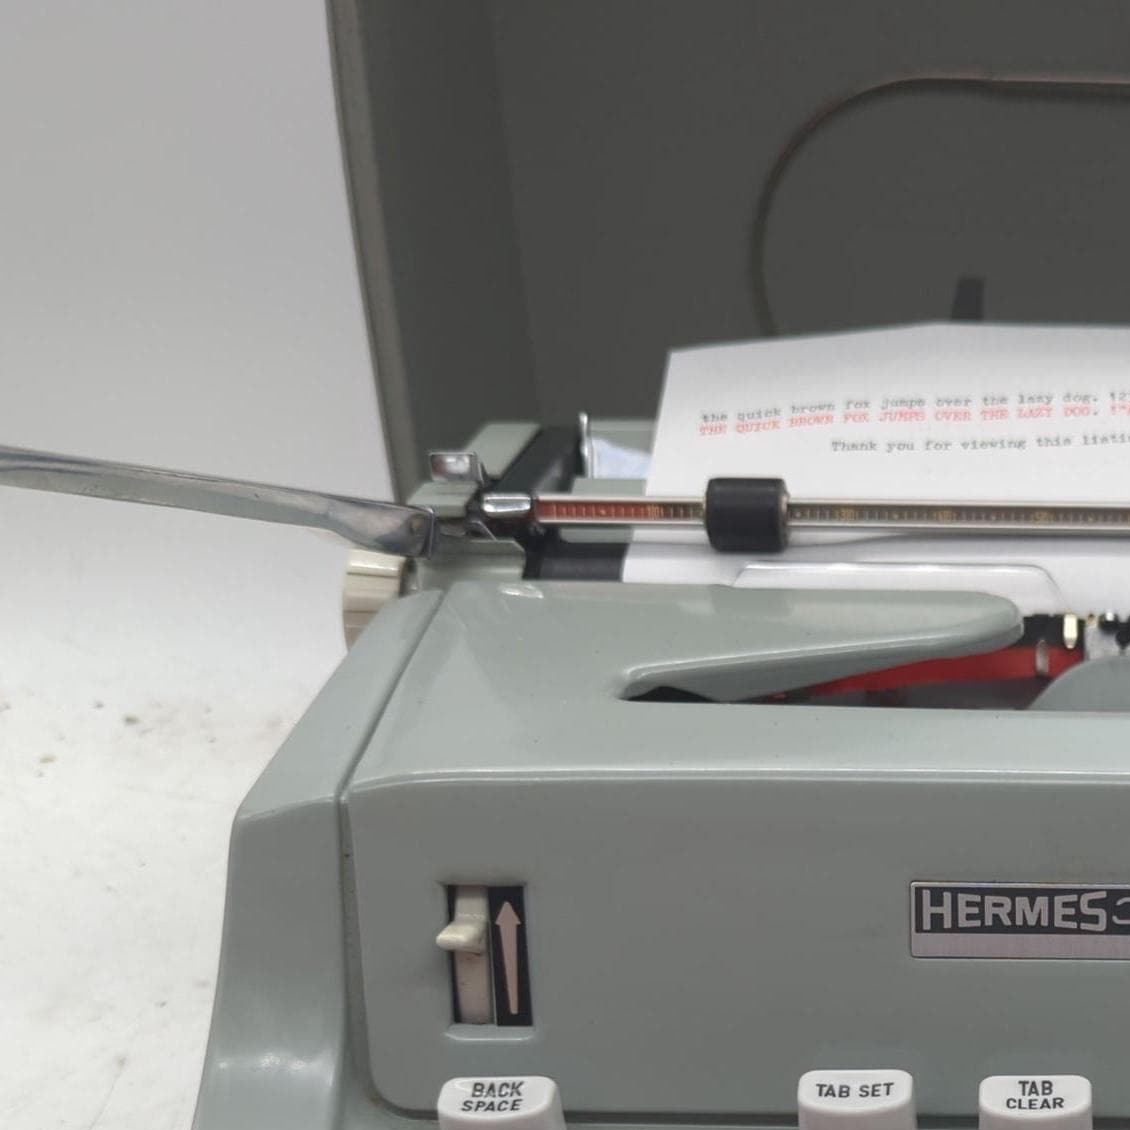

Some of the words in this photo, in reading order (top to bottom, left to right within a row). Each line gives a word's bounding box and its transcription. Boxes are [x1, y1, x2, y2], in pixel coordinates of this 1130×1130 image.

[737, 407, 780, 422] quick
[791, 401, 835, 414] brown
[936, 397, 972, 408] over
[736, 419, 780, 434] QUICK
[831, 439, 877, 452] Thank
[887, 441, 914, 454] you
[924, 439, 952, 451] for
[961, 438, 1026, 450] viewing
[1037, 436, 1071, 448] this
[922, 890, 1107, 932] HERMES
[471, 1081, 524, 1098] BACK
[816, 1083, 851, 1098] TAB
[858, 1082, 895, 1098] SET
[1017, 1080, 1053, 1097] TAB
[461, 1098, 523, 1112] SPACE
[1006, 1097, 1065, 1110] CLEAR
